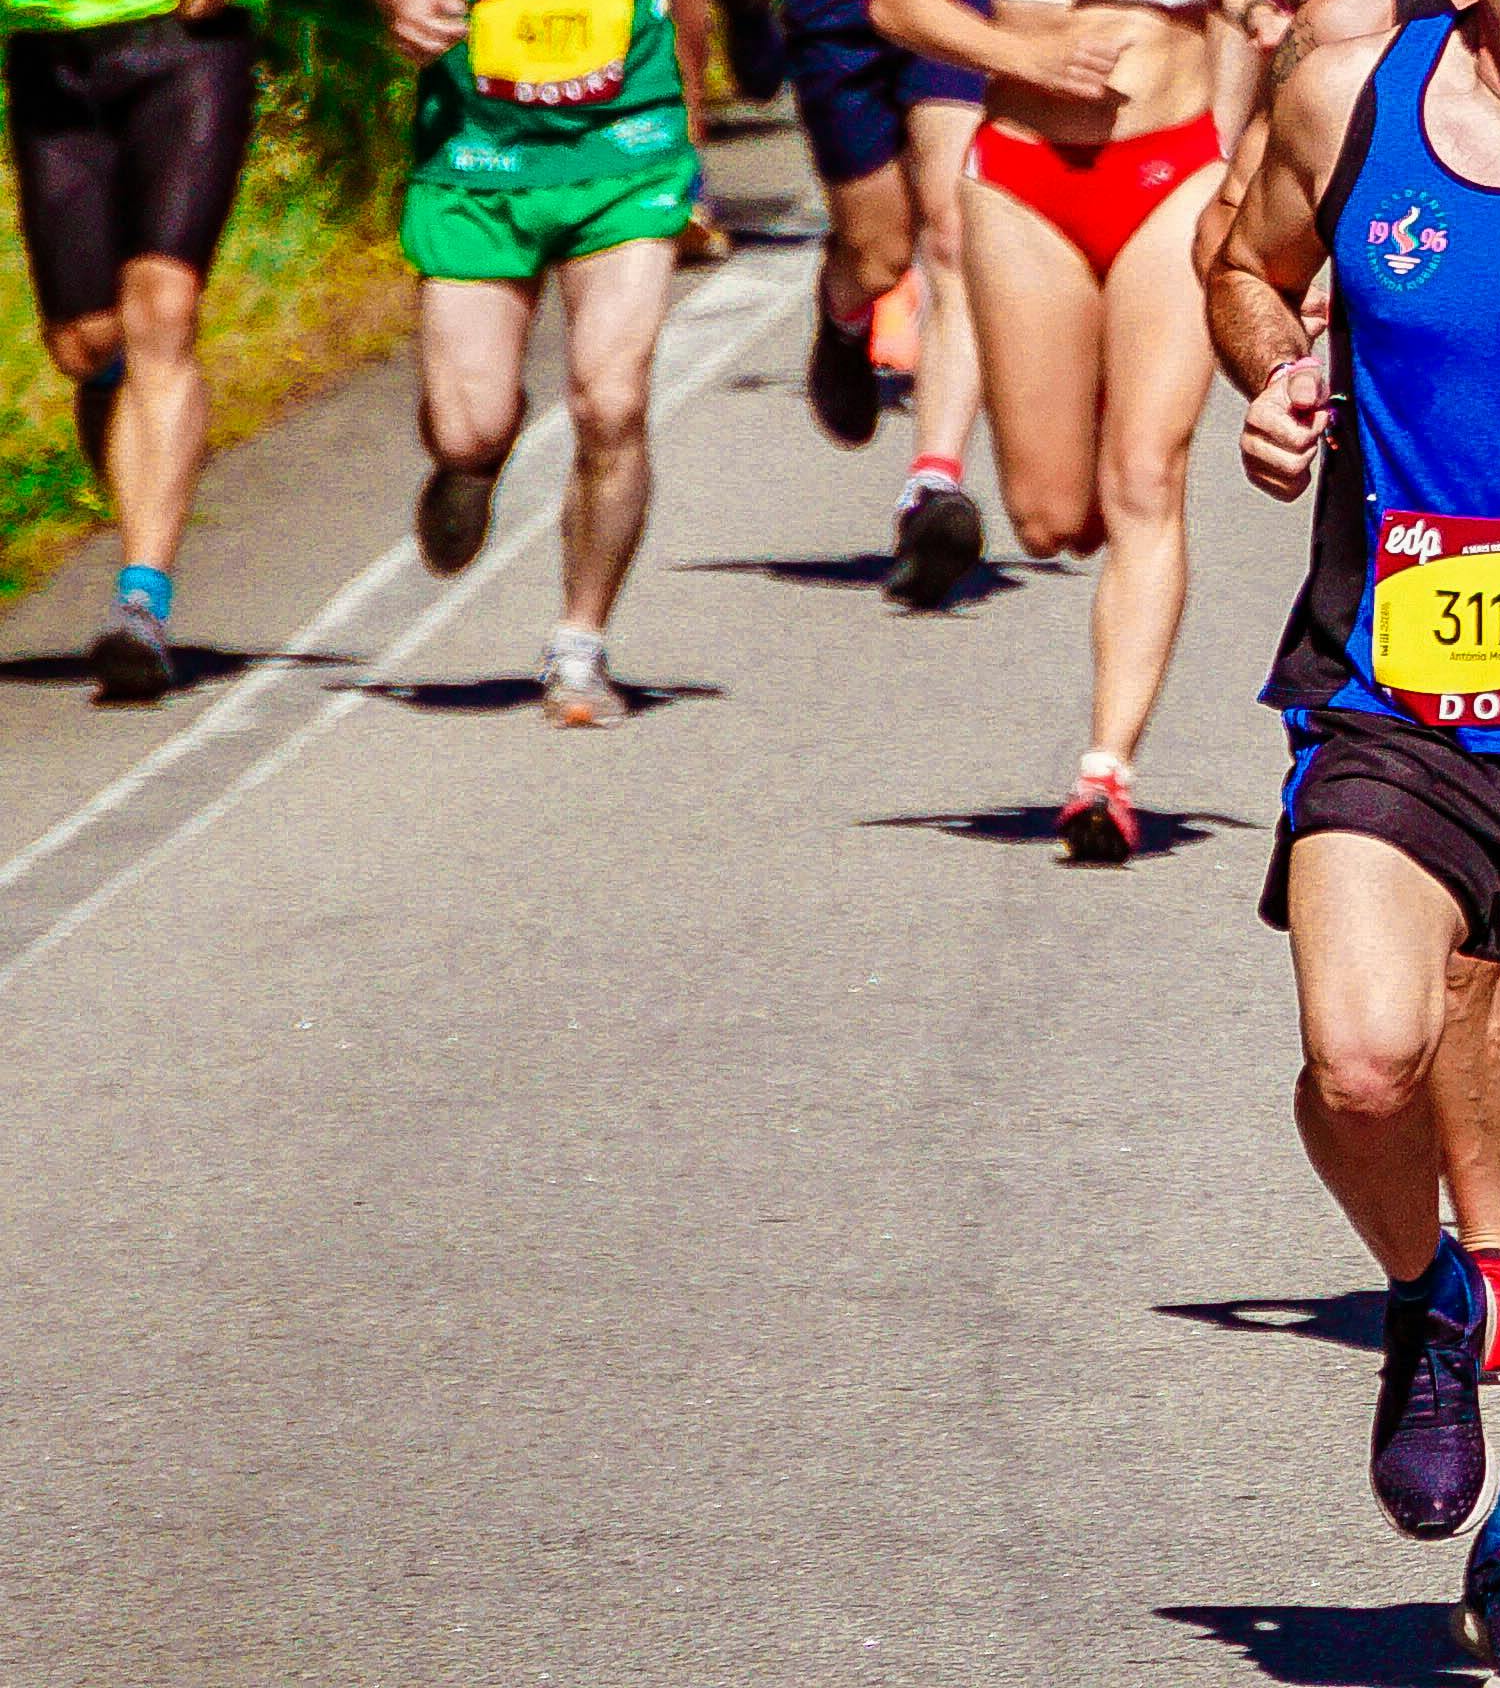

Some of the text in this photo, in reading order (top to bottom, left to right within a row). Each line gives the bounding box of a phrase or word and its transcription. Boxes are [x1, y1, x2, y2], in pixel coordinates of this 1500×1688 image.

[1367, 220, 1448, 252] 19 96
[1385, 519, 1443, 567] edp
